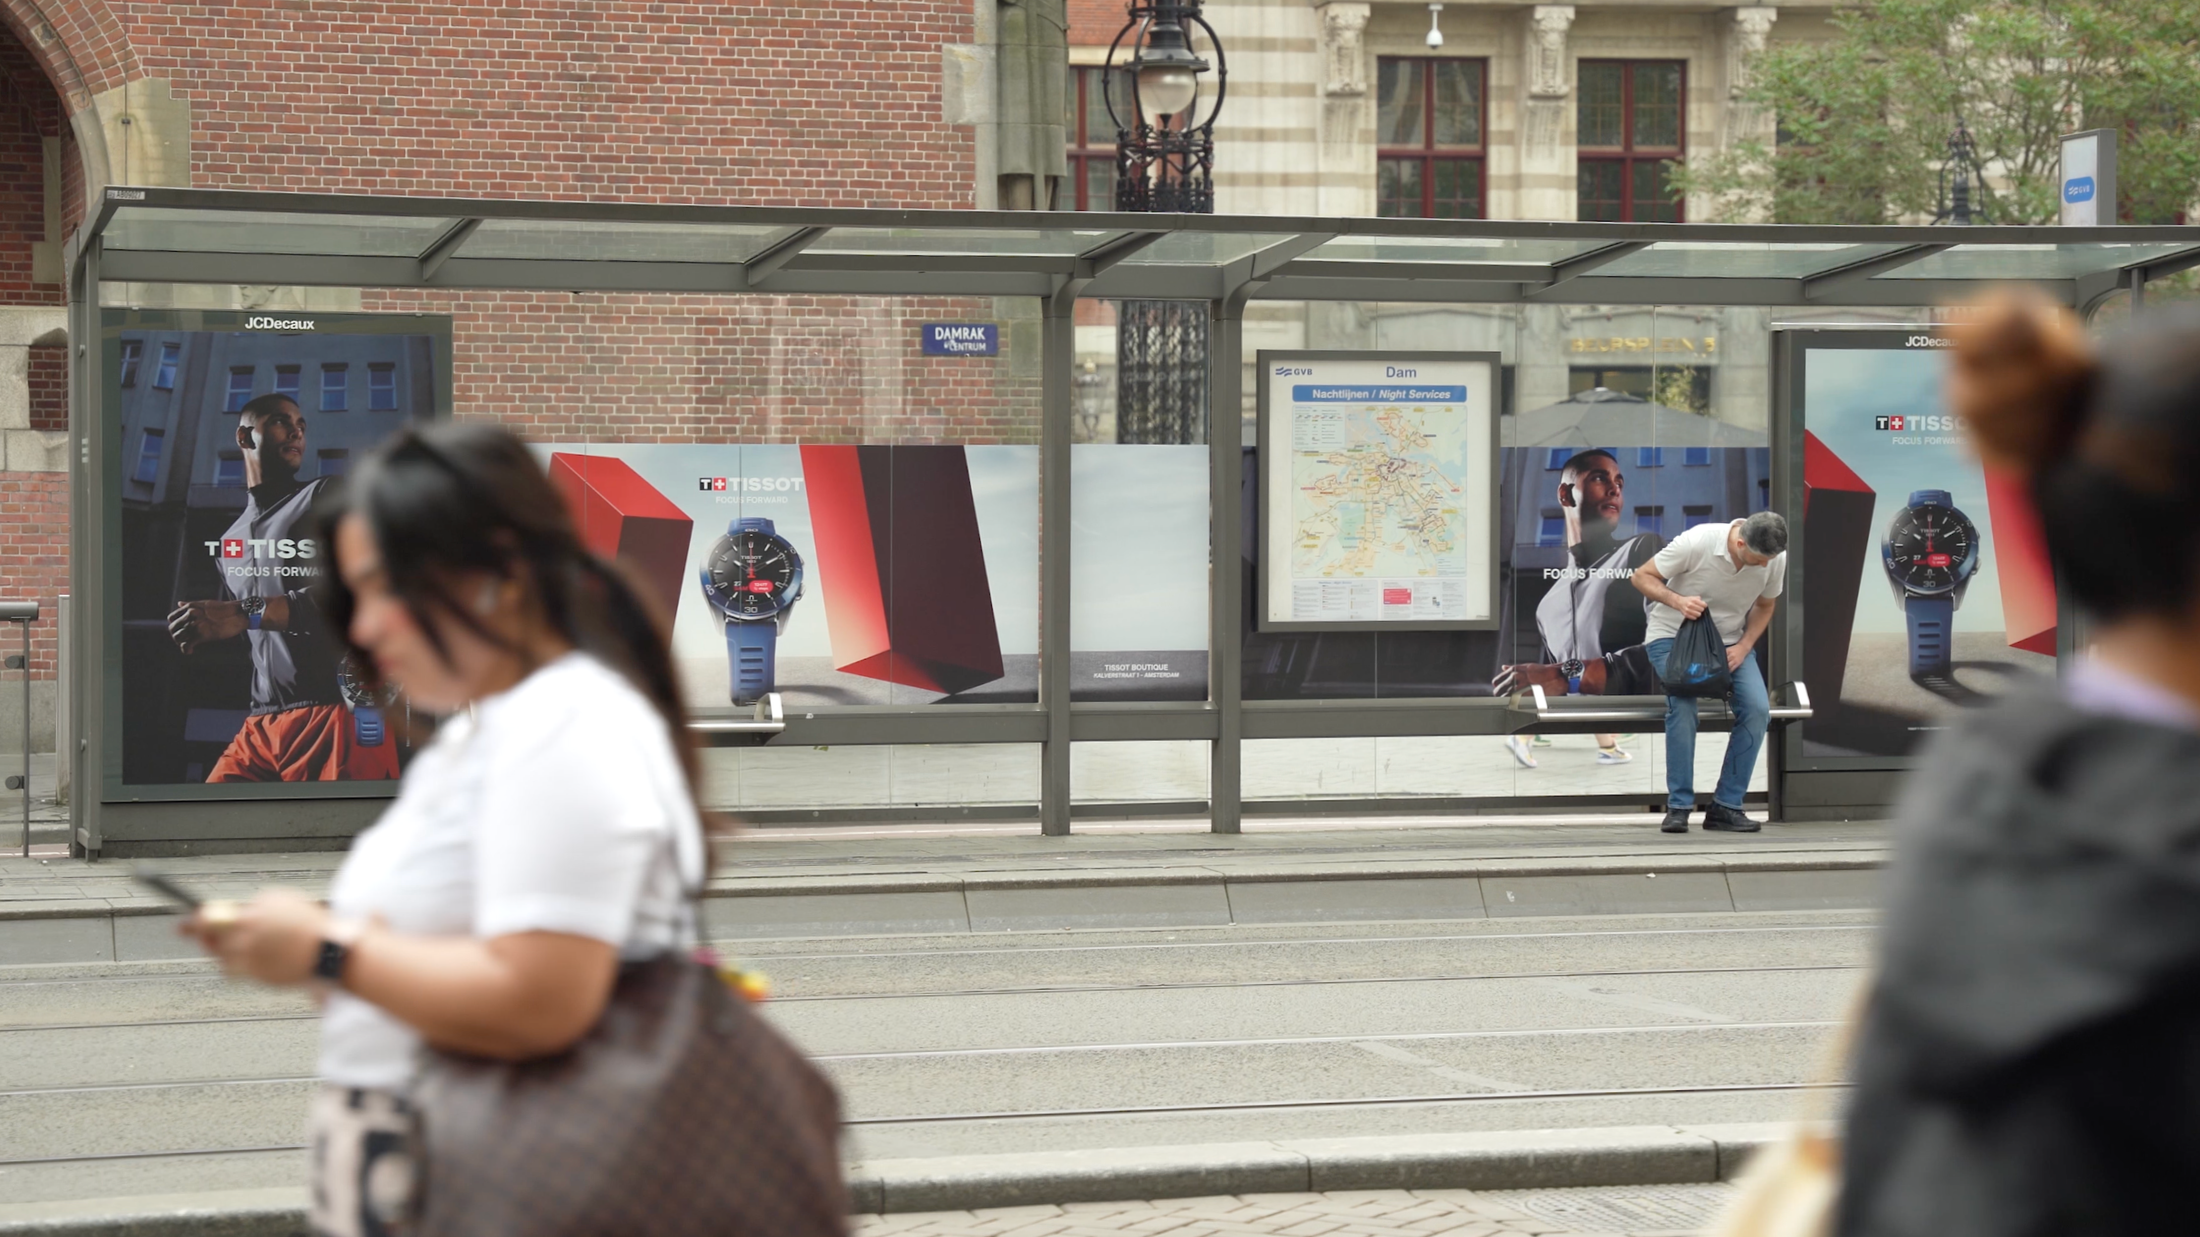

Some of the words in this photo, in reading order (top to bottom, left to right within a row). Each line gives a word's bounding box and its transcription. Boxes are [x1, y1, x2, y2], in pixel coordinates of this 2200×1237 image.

[245, 317, 315, 330] JCDecaux
[935, 327, 985, 340] DAMRAK
[949, 342, 986, 351] CENTRUM
[1293, 368, 1313, 376] GVB
[1386, 366, 1417, 378] Dam
[1312, 389, 1369, 400] Nachtlijnen
[1379, 389, 1406, 400] Night
[1408, 389, 1451, 399] Services
[1877, 418, 1888, 429] T
[1906, 416, 1966, 431] TISSO
[1892, 437, 1922, 445] FOCUS
[1924, 437, 1962, 445] FORWAR
[700, 479, 711, 490] T
[729, 478, 804, 491] TISSOT
[716, 496, 744, 504] FOCUS
[746, 496, 788, 504] FORWARD
[204, 541, 219, 556] T
[247, 538, 317, 559] TISS
[227, 567, 270, 577] FOCUS
[273, 567, 319, 577] FORWA
[1543, 568, 1586, 580] FOCUS
[1589, 568, 1636, 579] FORWA
